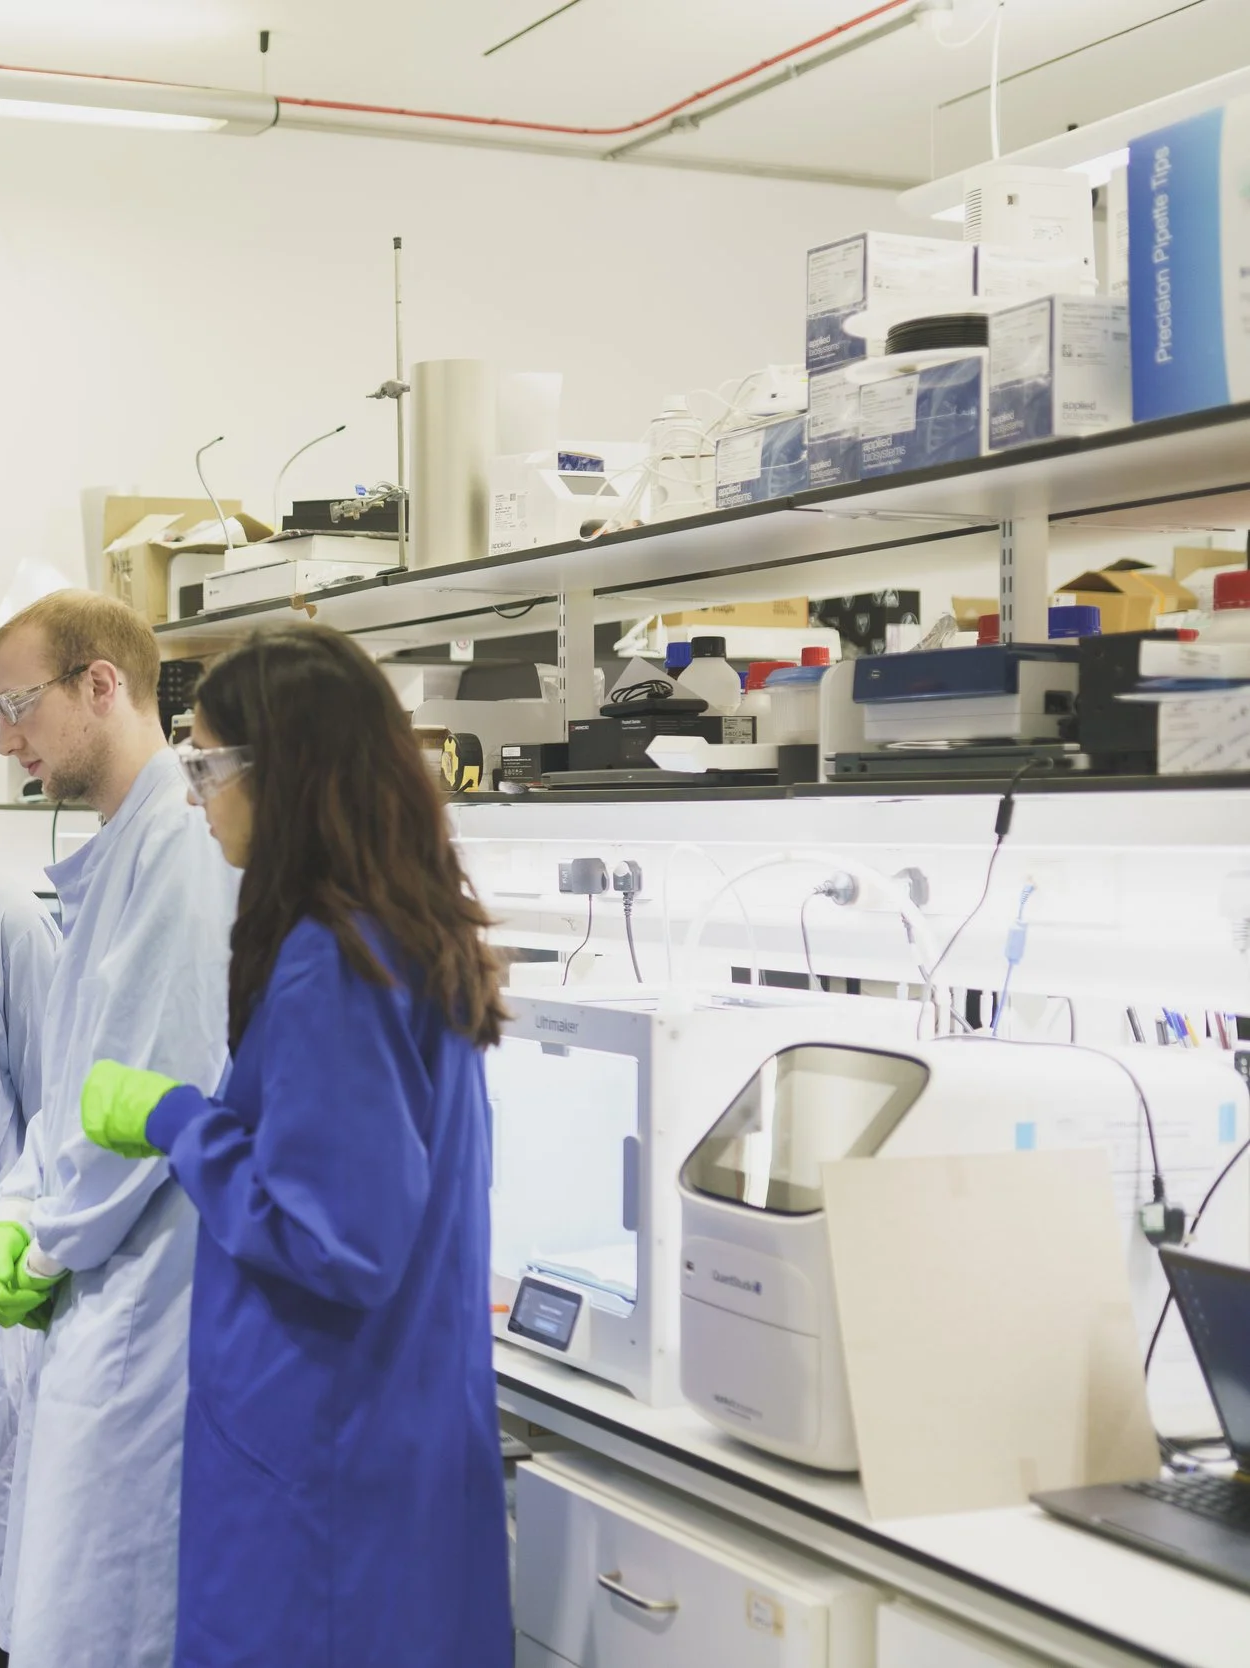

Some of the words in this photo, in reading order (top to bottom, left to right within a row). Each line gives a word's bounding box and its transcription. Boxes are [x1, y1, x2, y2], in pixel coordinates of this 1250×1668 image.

[1150, 145, 1172, 191] Tips
[1152, 193, 1173, 264] Pipette
[1154, 267, 1173, 365] Precision
[808, 334, 831, 348] applied
[1062, 400, 1096, 411] applied
[861, 434, 893, 452] applied
[862, 445, 906, 463] biosystems
[810, 459, 832, 471] applied
[717, 484, 742, 497] applied
[718, 492, 752, 508] biosystems
[535, 1014, 579, 1035] Ultimaker
